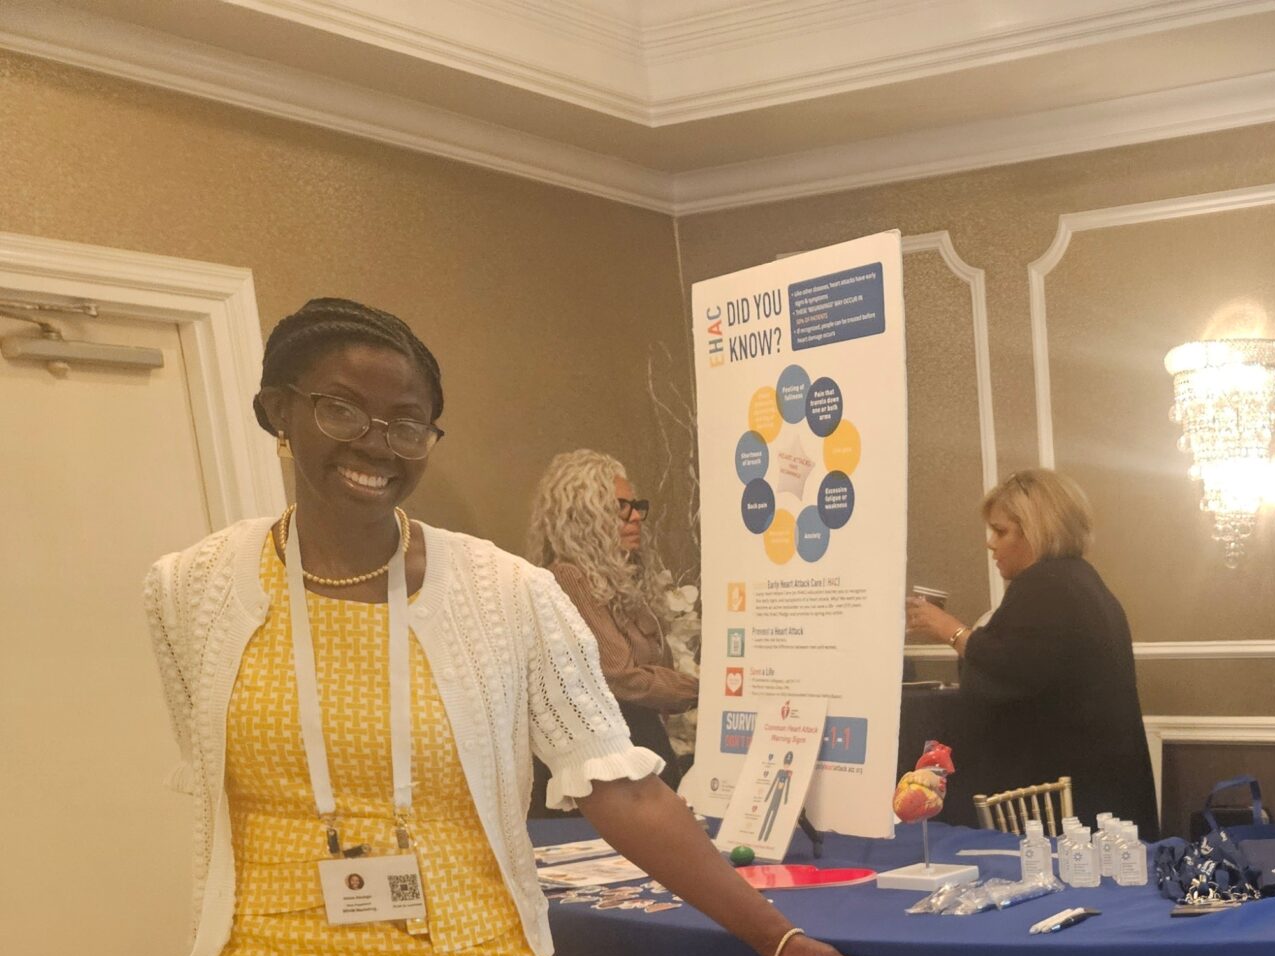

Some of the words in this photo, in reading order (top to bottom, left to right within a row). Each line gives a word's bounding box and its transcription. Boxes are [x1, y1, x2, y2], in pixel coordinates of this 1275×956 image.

[727, 297, 750, 327] DID
[753, 289, 782, 320] YOU
[729, 327, 782, 362] KNOW?
[726, 712, 756, 731] SURVI
